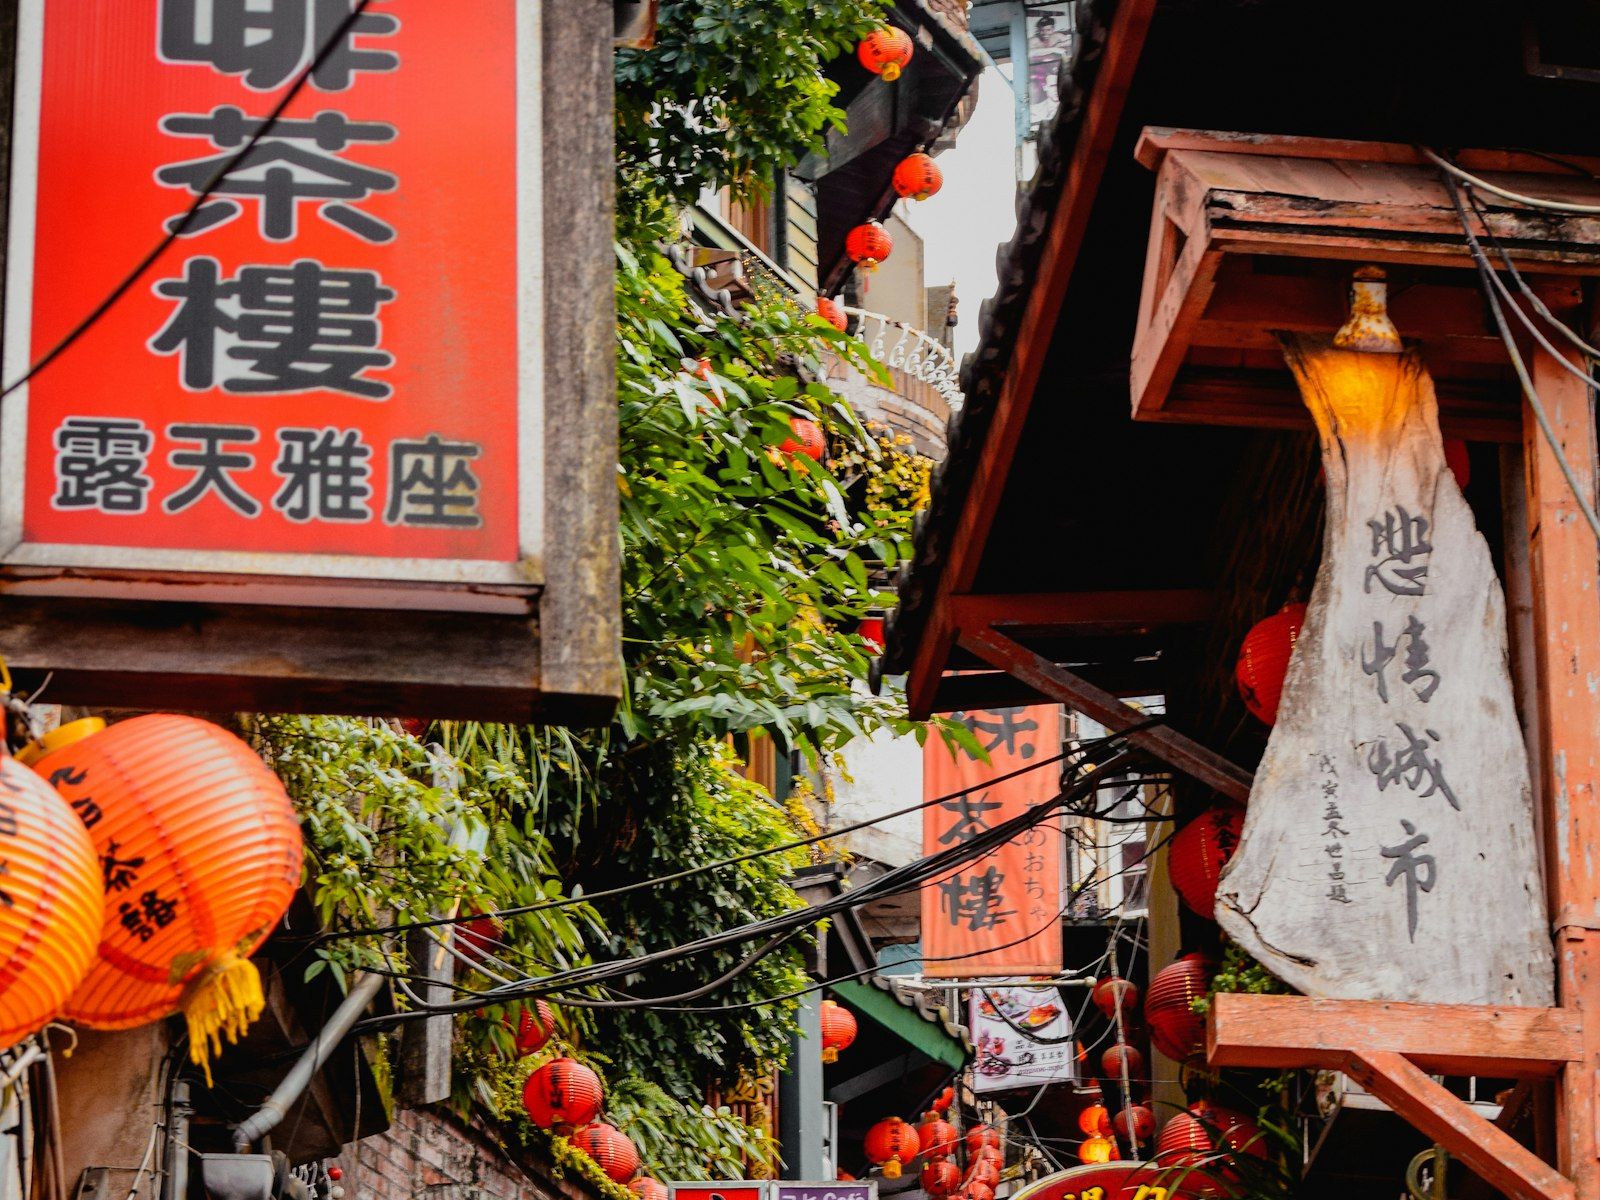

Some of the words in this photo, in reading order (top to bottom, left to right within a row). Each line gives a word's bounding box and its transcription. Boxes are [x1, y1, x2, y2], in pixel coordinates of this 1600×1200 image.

[52, 416, 483, 528] 露天雅座
[1361, 505, 1461, 944] 悲情城市
[1023, 800, 1049, 921] めおちゃ
